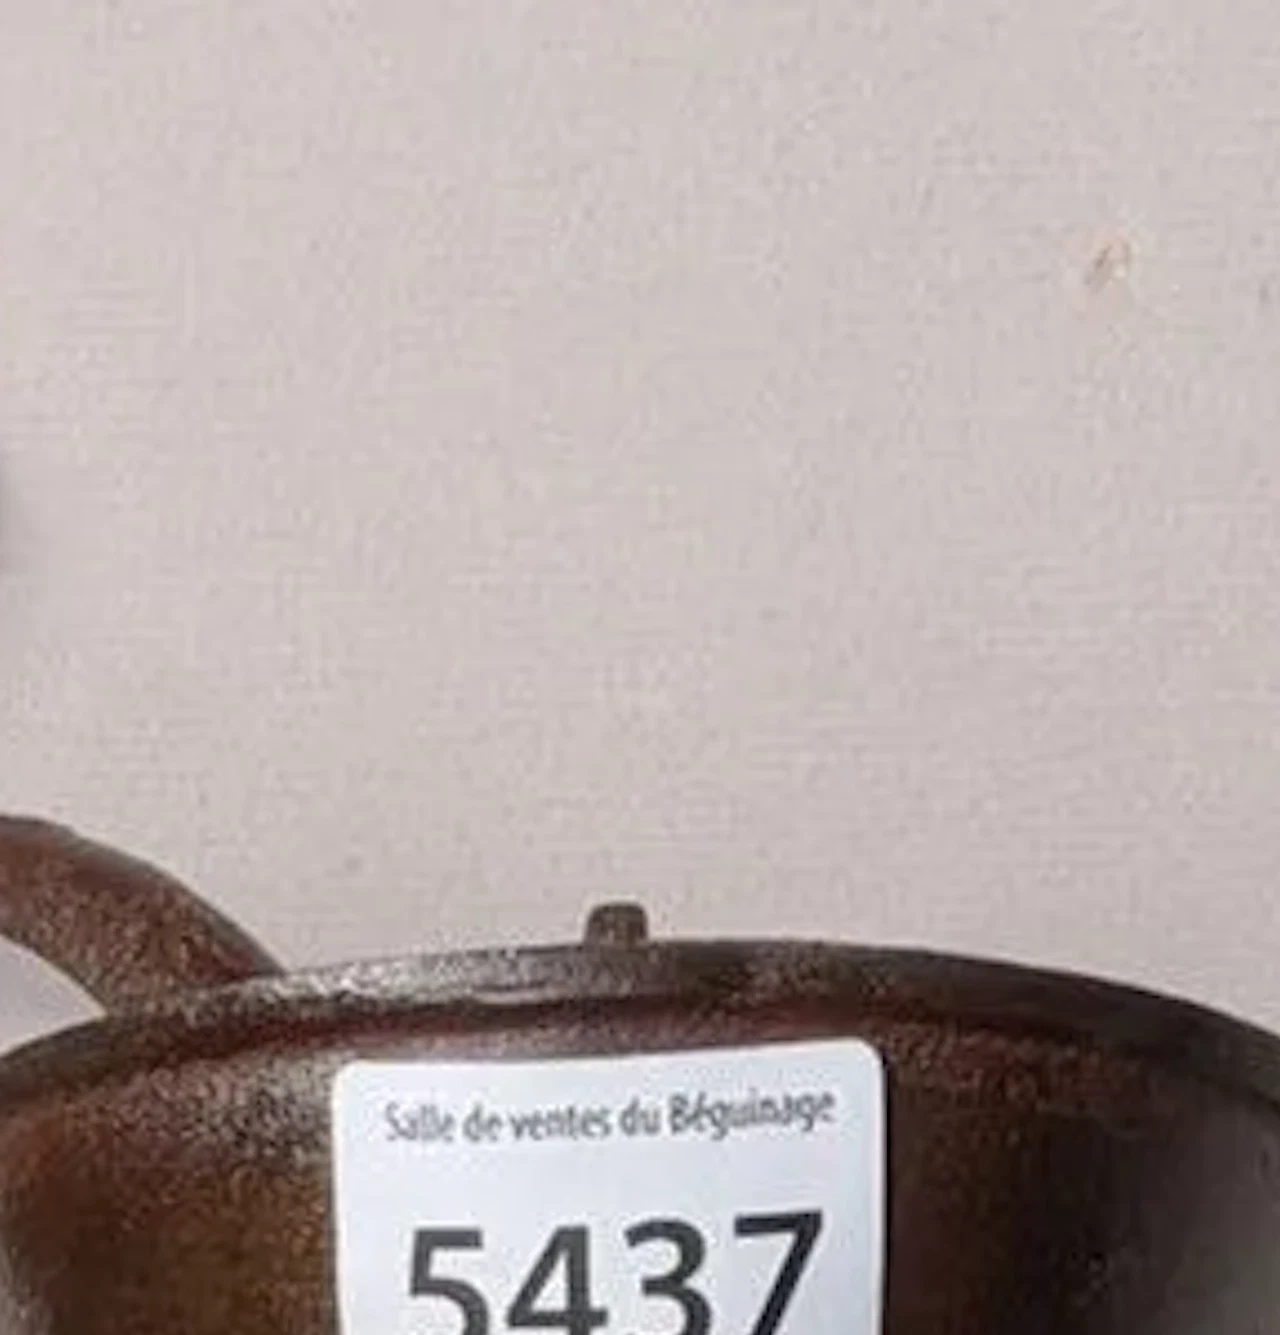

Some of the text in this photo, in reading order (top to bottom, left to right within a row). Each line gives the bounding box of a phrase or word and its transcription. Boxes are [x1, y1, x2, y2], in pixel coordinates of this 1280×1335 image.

[386, 1092, 838, 1142] Salle de ventes du Béguinage
